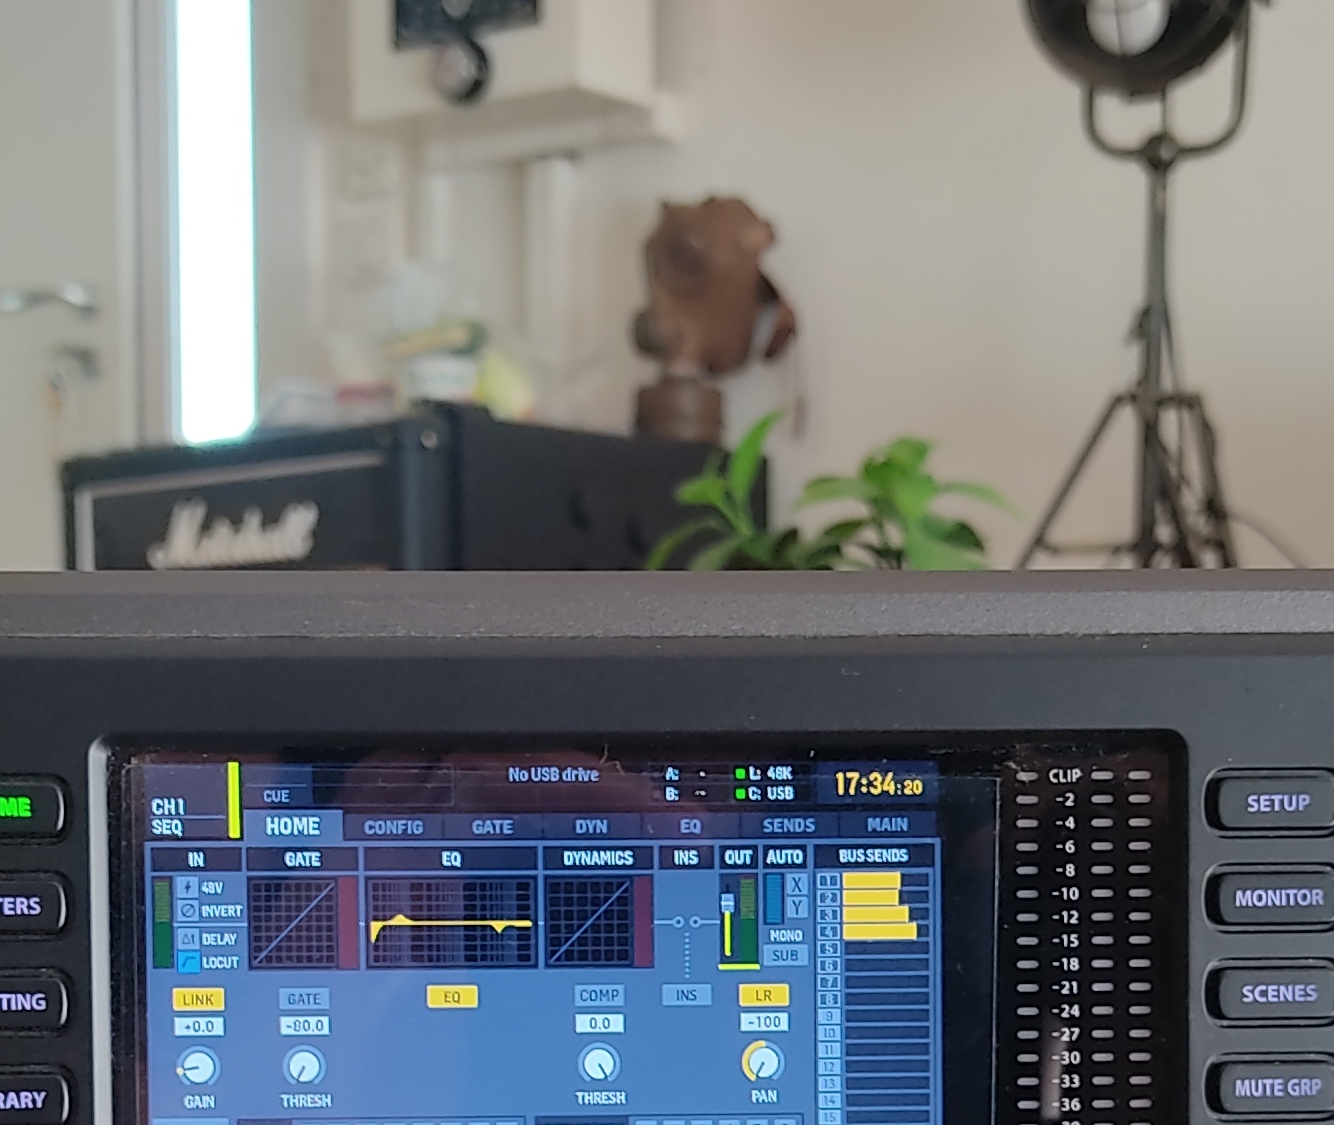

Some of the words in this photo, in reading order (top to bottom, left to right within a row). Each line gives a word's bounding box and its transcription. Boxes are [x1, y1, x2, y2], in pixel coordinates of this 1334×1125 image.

[509, 767, 528, 783] No
[531, 766, 559, 782] USB
[562, 766, 599, 782] drive
[1049, 769, 1082, 783] CLIP
[835, 772, 923, 797] 17:34:20
[263, 789, 290, 803] CUE
[1056, 792, 1075, 806] -2
[1247, 794, 1310, 813] SETUP
[151, 819, 183, 838] SEQ
[266, 816, 321, 836] HOME
[364, 820, 424, 835] CONFIG
[471, 818, 514, 835] GATE
[575, 818, 608, 835] DYN
[680, 819, 702, 834] EQ
[762, 818, 815, 833] SENDS
[867, 817, 908, 832] MAIN
[1056, 816, 1075, 829] -4
[1056, 840, 1075, 853] -6
[187, 851, 206, 868] IN
[284, 851, 322, 868] GATE
[441, 852, 462, 869] EQ
[563, 850, 634, 867] DYNAMICS
[673, 849, 699, 866] INS
[724, 849, 753, 865] OUT
[766, 849, 804, 865] AUTO
[839, 848, 865, 864] BUS
[866, 848, 909, 864] SENDS
[1056, 863, 1075, 877] -8
[1052, 887, 1080, 900] -10
[1235, 889, 1324, 908] MONITOR
[201, 905, 244, 918] INVERT
[1052, 910, 1079, 924] -12
[201, 933, 237, 946] DELAY
[770, 929, 803, 942] MONO
[1052, 934, 1079, 947] -15
[203, 956, 240, 969] LOCUT
[771, 948, 799, 963] SUB
[1052, 957, 1080, 971] -18
[1052, 981, 1078, 994] -21
[1242, 984, 1317, 1002] SCENES
[183, 993, 214, 1006] LINK
[288, 993, 321, 1005] GATE
[444, 990, 461, 1005] EQ
[579, 988, 620, 1003] COMP
[676, 988, 697, 1002] INS
[755, 988, 772, 1003] LR
[1052, 1004, 1080, 1018] -24
[1052, 1028, 1080, 1041] -27
[1052, 1051, 1080, 1065] -30
[1052, 1074, 1080, 1088] -33
[1235, 1079, 1284, 1098] MUTE
[1287, 1079, 1322, 1097] GRP
[183, 1095, 215, 1109] GAIN
[281, 1094, 332, 1108] THRESH
[575, 1092, 627, 1105] THRESH
[751, 1090, 778, 1104] PAN
[1052, 1098, 1081, 1112] -36
